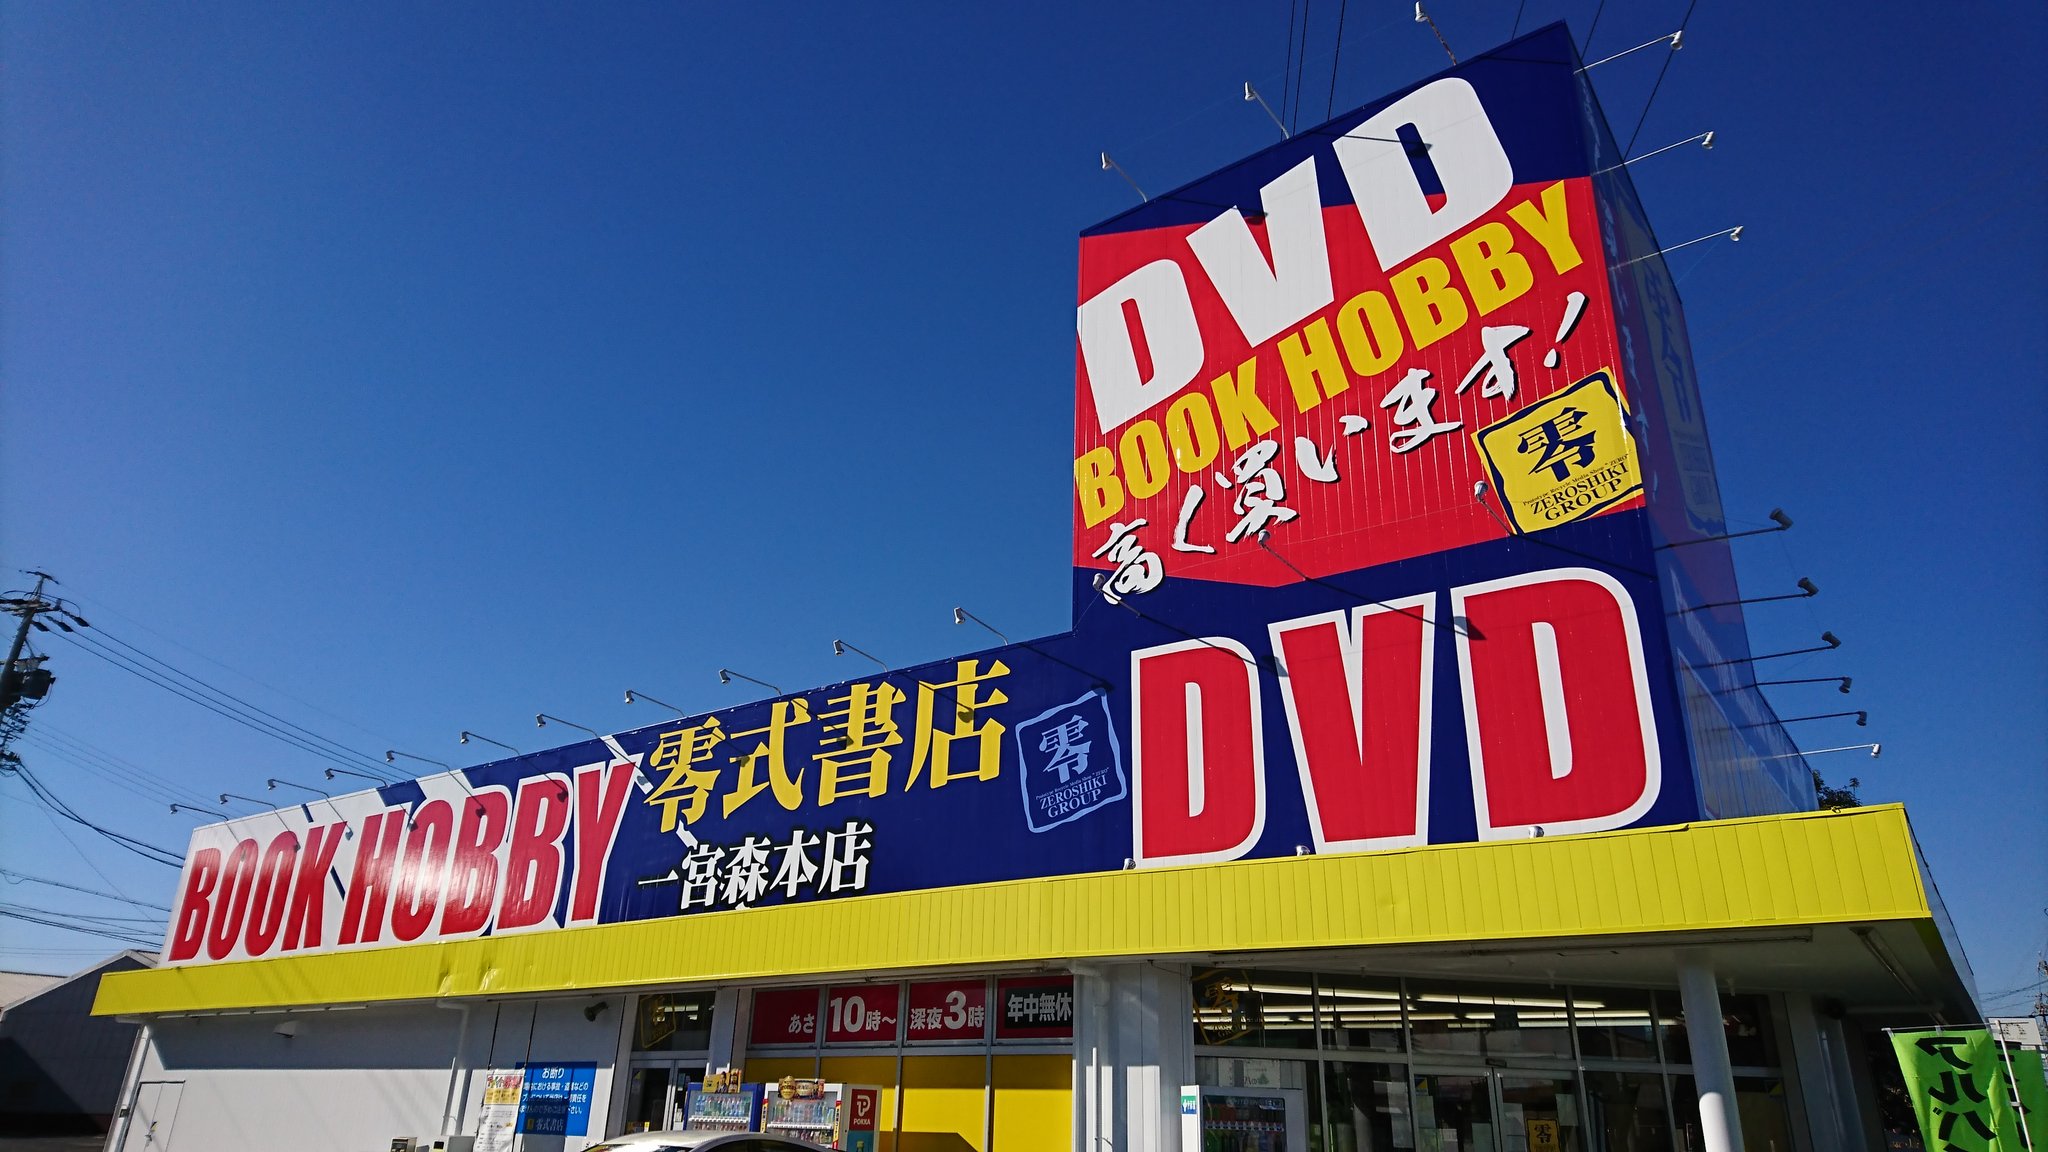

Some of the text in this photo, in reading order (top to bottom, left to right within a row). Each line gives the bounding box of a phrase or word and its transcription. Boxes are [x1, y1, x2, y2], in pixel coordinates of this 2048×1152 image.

[1076, 76, 1514, 435] DVD
[1074, 180, 1583, 529] BOOK HOBBY
[1517, 407, 1597, 482] 零
[1530, 462, 1629, 515] ZEROSHIKI
[1545, 478, 1622, 521] GROUP
[644, 659, 1011, 833] 零式書店
[1039, 715, 1092, 784] 零
[1131, 567, 1661, 868] DVD
[1039, 774, 1107, 810] ZEROSHIKI
[1047, 788, 1101, 818] GROUP
[169, 760, 640, 962] BOOK HOBBY
[638, 821, 873, 910] 一宮森本店
[788, 1013, 815, 1034] あさ
[910, 991, 985, 1030] 深夜3時
[1007, 992, 1072, 1023] 年中無休
[541, 1066, 565, 1079] お断り
